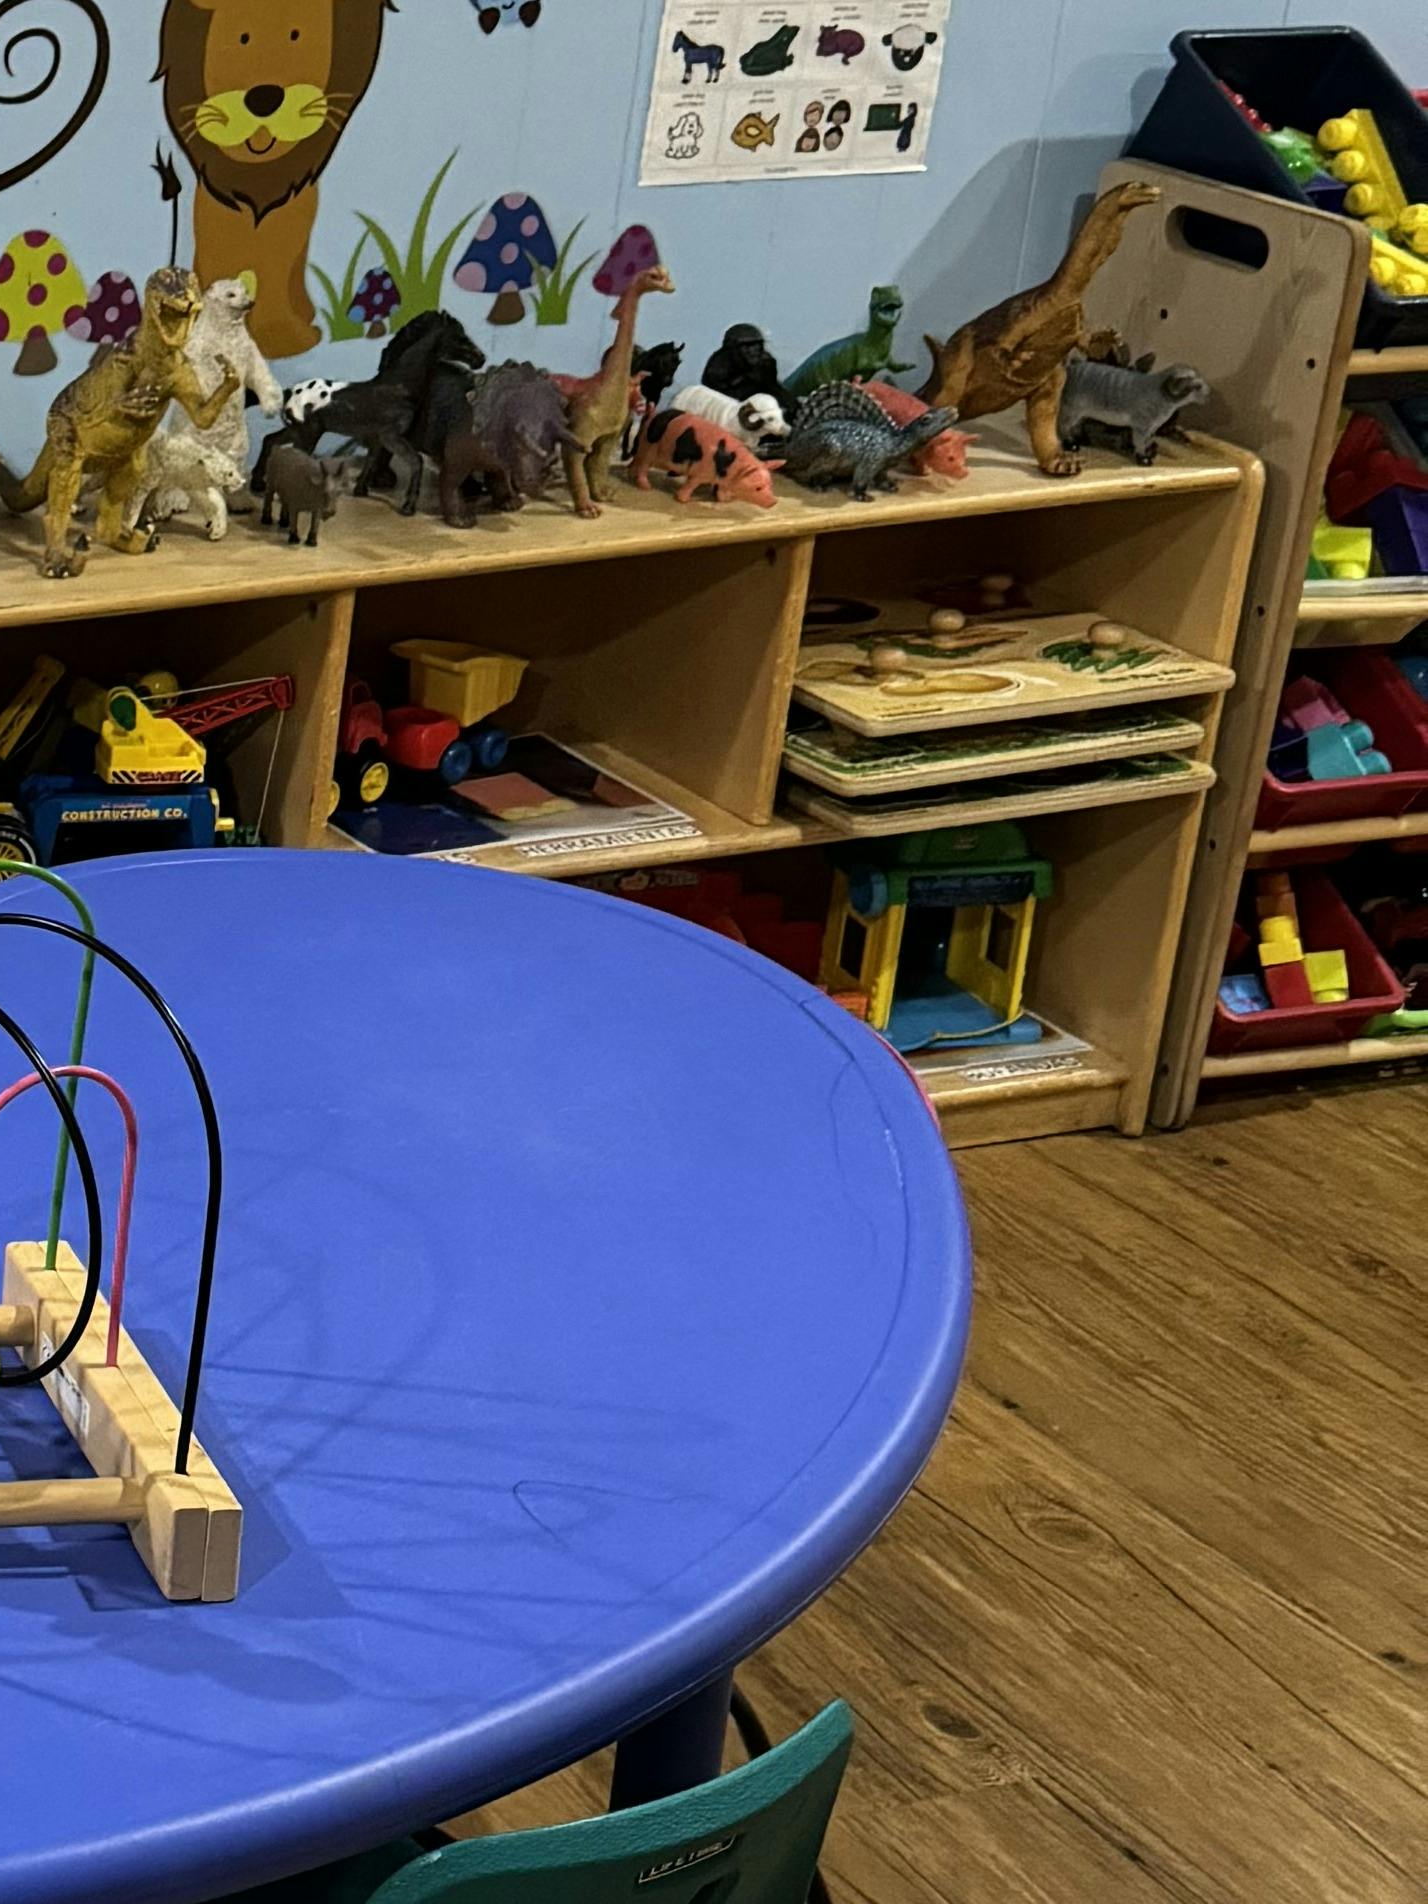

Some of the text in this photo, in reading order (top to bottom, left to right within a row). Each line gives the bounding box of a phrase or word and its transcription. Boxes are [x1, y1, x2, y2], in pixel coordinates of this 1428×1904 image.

[61, 807, 188, 822] CONSTRUCTION CO.
[521, 825, 699, 857] HERRAMIENTAS
